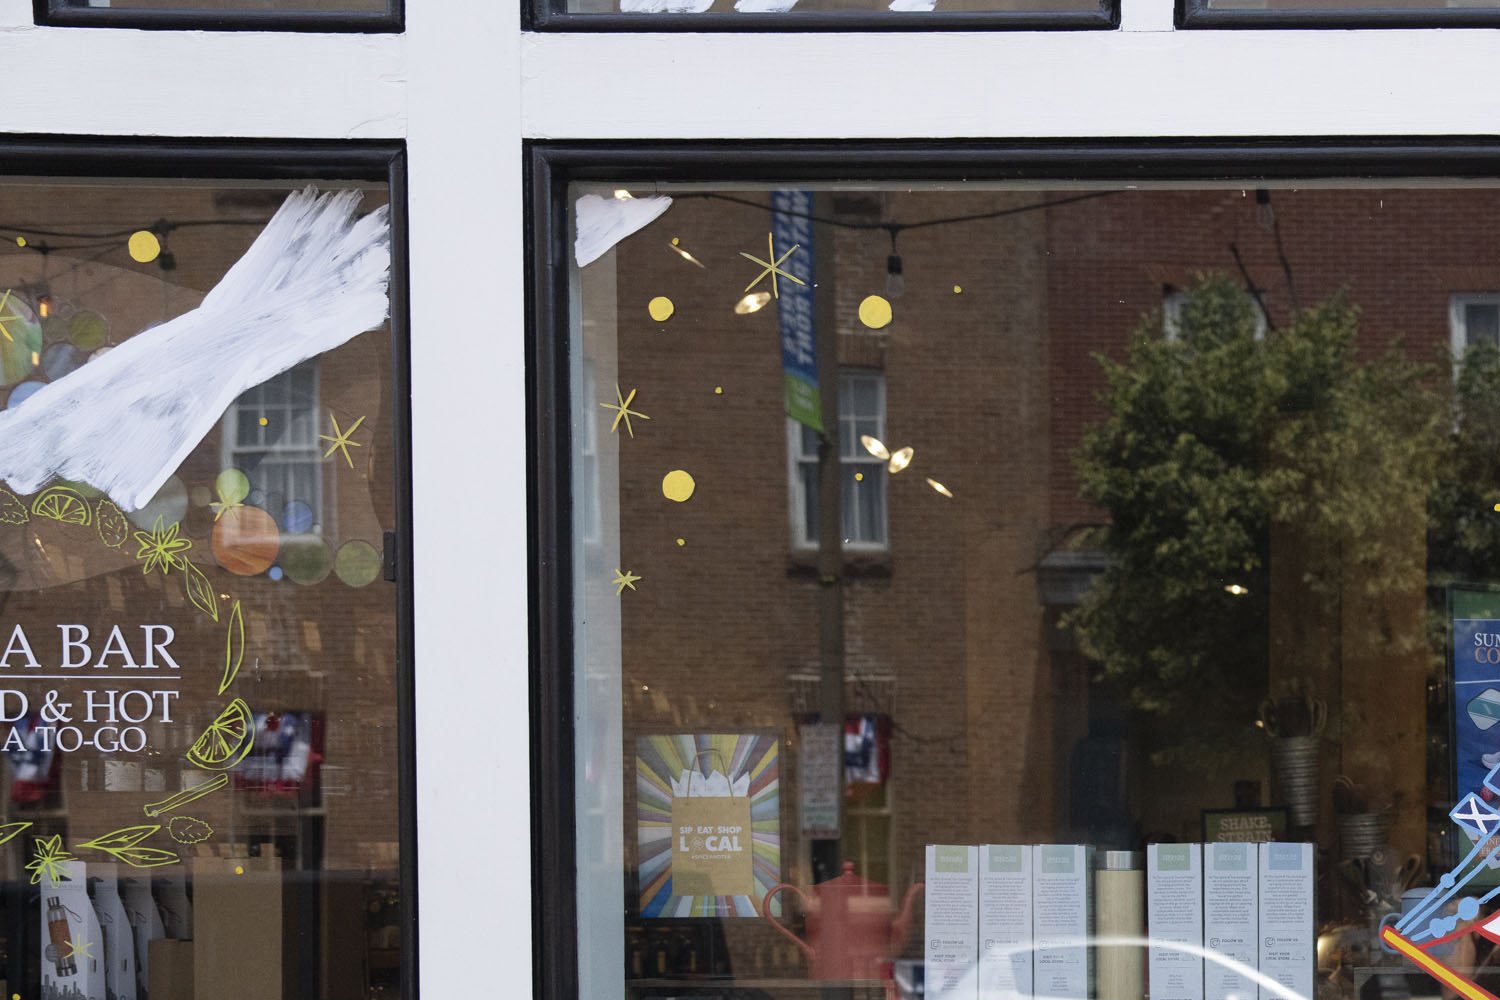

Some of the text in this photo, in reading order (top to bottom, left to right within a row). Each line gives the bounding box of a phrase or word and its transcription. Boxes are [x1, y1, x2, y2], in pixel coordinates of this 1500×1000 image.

[57, 624, 180, 668] BAR
[40, 689, 73, 722] &
[83, 690, 179, 723] HOT
[35, 726, 147, 752] TO-GO
[680, 826, 742, 834] SIP EAT SHOP
[1220, 816, 1272, 831] SHAKE.
[1218, 830, 1276, 842] STRAIN.
